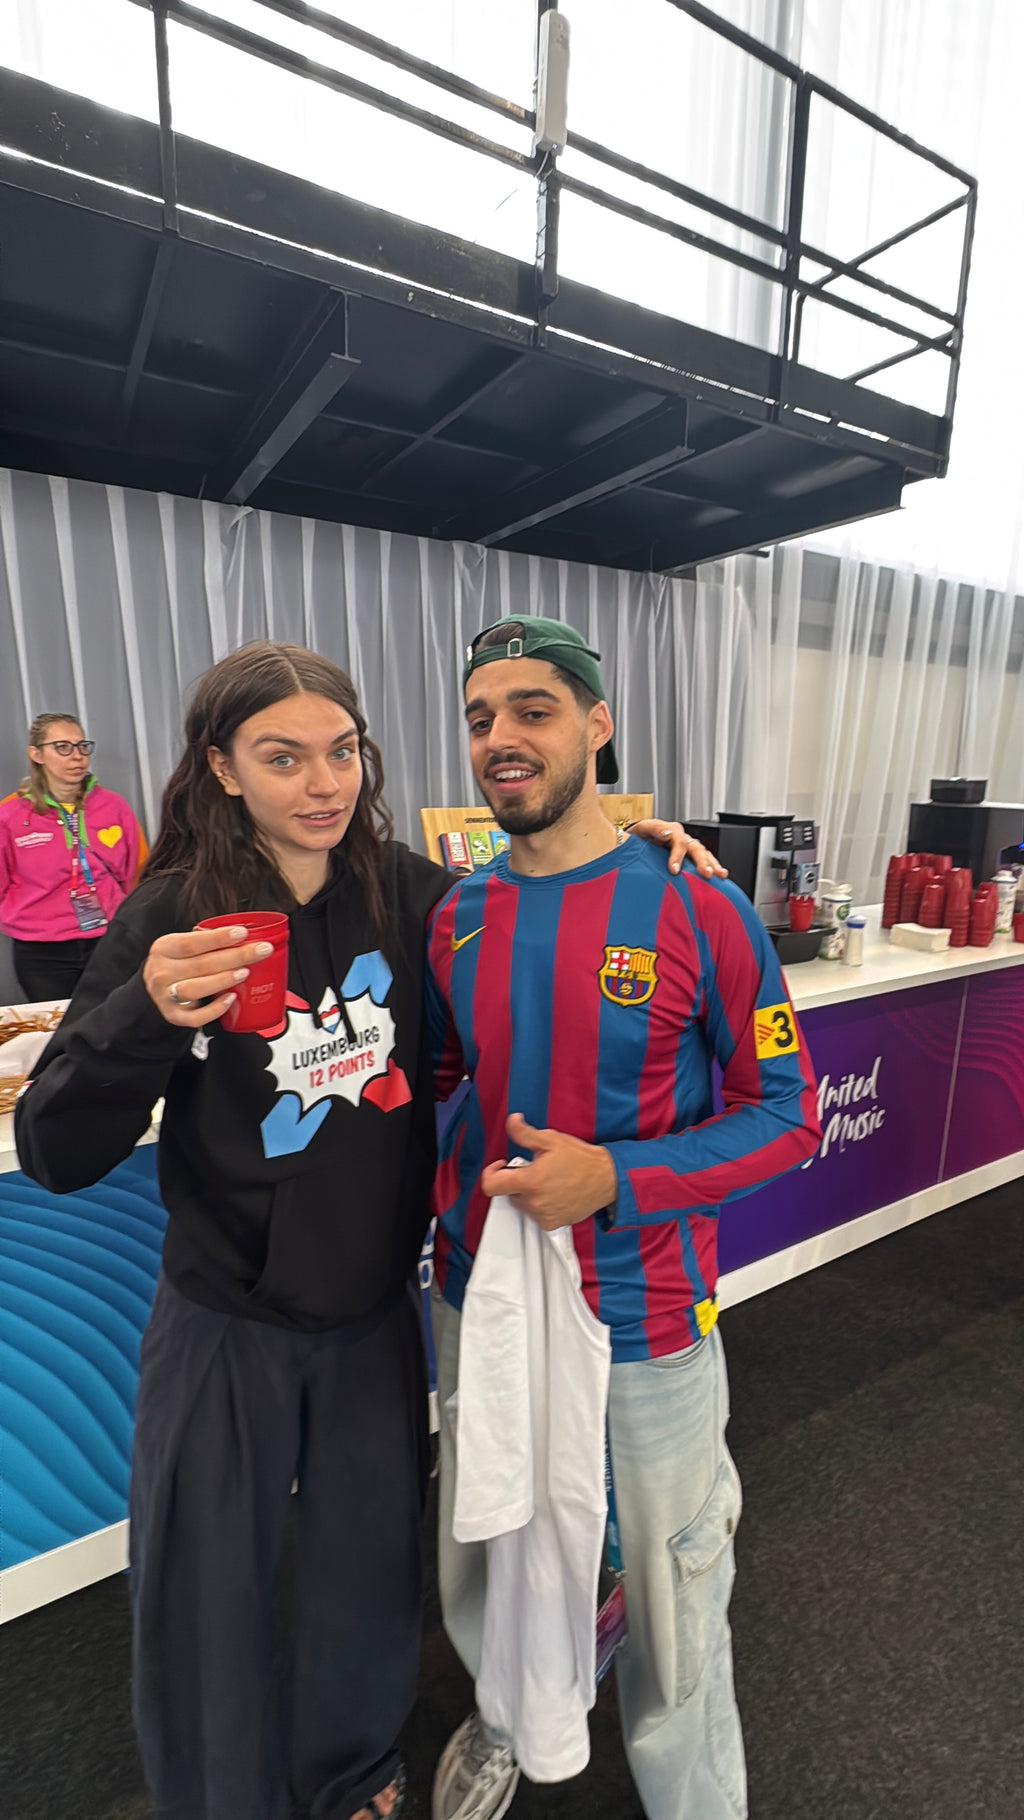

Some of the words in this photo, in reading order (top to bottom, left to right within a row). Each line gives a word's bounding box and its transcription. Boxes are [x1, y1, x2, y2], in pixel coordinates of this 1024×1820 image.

[250, 982, 275, 995] HOT
[771, 1010, 793, 1048] 3
[309, 1068, 324, 1088] 12
[328, 1050, 375, 1082] POINTS
[820, 1105, 886, 1158] Music
